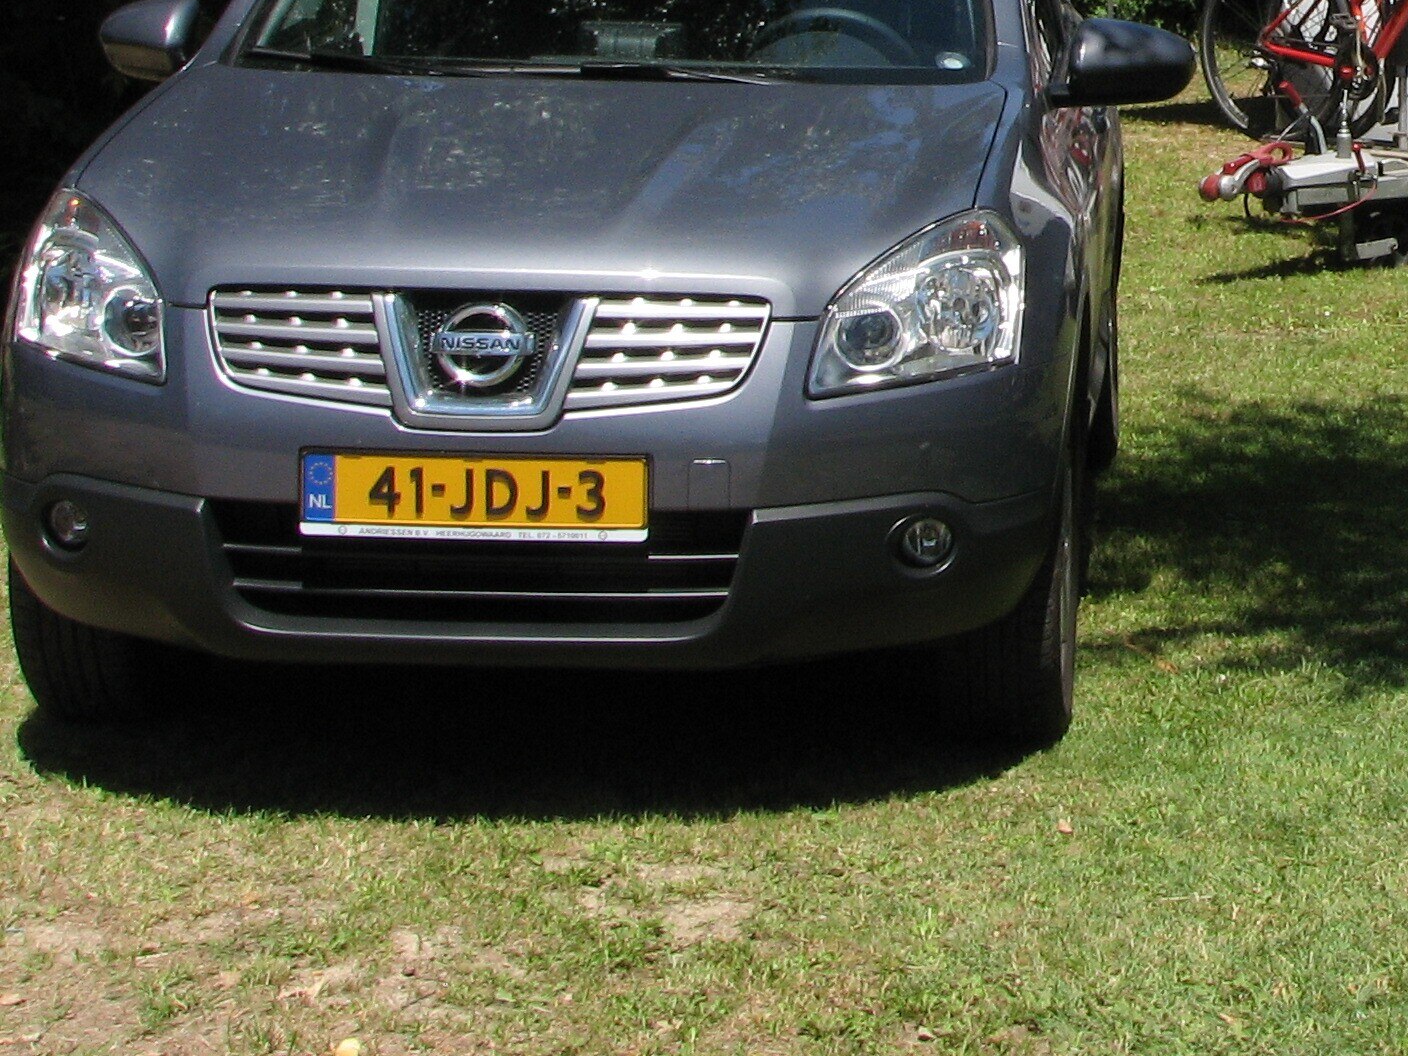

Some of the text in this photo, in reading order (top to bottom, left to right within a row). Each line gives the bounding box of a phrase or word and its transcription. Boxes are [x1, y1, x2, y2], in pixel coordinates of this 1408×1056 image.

[441, 337, 520, 350] NISSAN
[308, 493, 332, 509] NL
[368, 465, 607, 521] 41-JDJ-3
